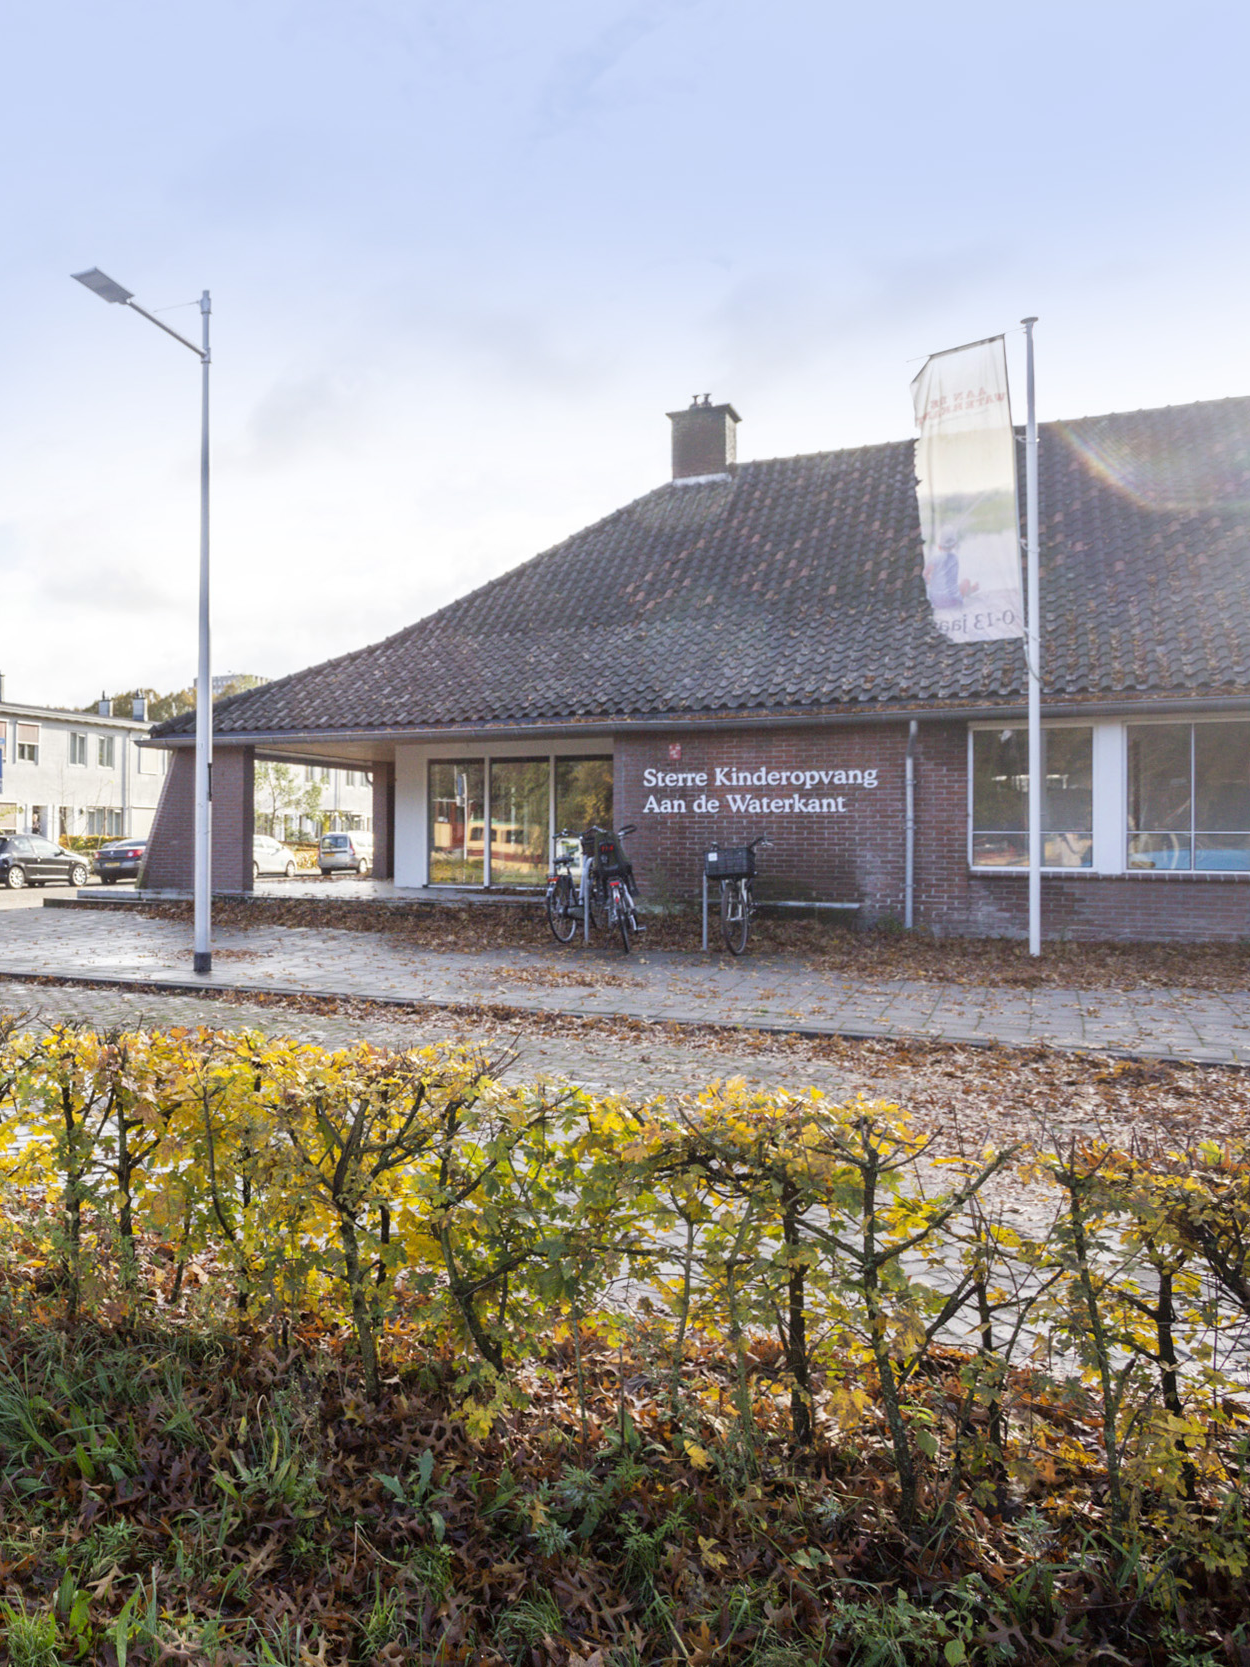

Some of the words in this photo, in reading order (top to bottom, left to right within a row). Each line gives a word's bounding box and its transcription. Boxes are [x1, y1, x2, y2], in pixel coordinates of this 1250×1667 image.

[643, 768, 708, 787] Sterre
[714, 766, 879, 789] Kinderopvang
[642, 794, 687, 813] Aan
[692, 795, 720, 813] de
[725, 793, 847, 813] Waterkant
